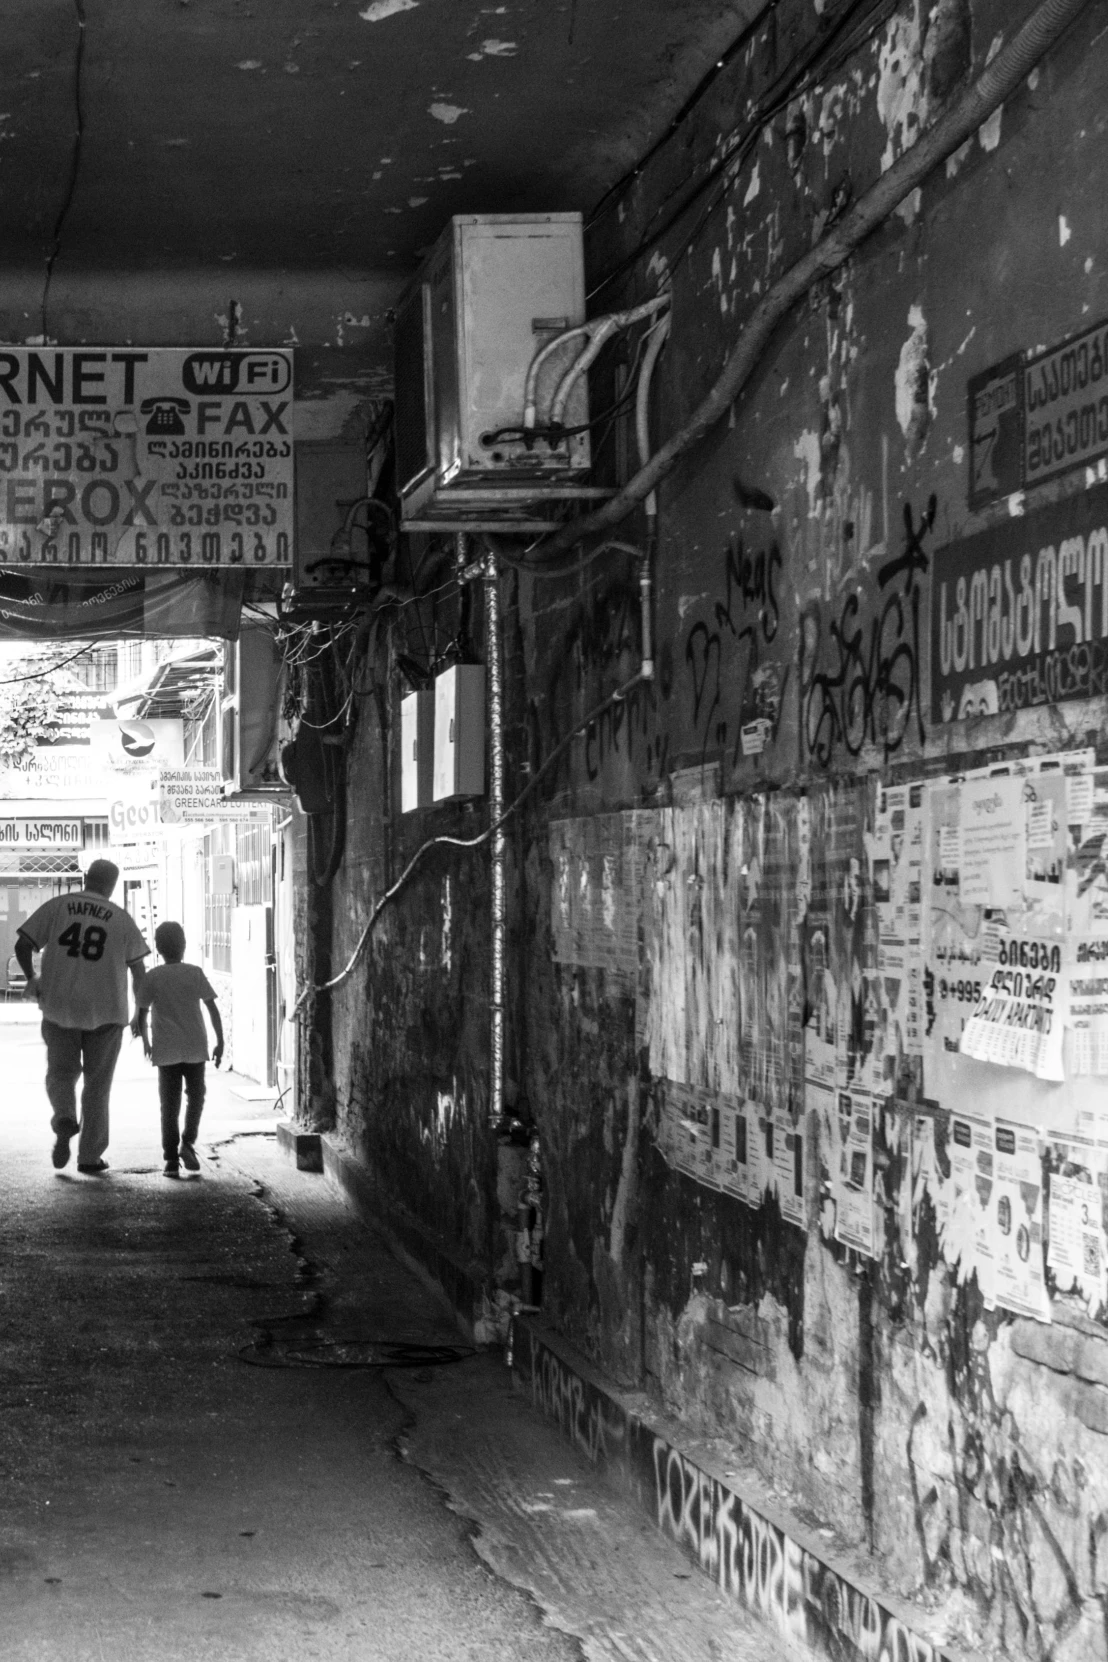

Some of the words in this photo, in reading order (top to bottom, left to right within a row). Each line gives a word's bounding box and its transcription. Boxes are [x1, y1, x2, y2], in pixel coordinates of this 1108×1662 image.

[1027, 332, 1108, 412] საათებ
[196, 401, 290, 435] FAX
[147, 441, 291, 460] ლამინირება
[176, 461, 266, 481] აკინძვა
[160, 482, 289, 501] ლაზერული
[135, 531, 289, 564] ნივთები
[174, 797, 228, 809] GREENCARD
[24, 822, 80, 845] სალონი
[66, 901, 114, 923] HAFNER
[58, 921, 108, 962] 48
[998, 938, 1061, 974] ბინები
